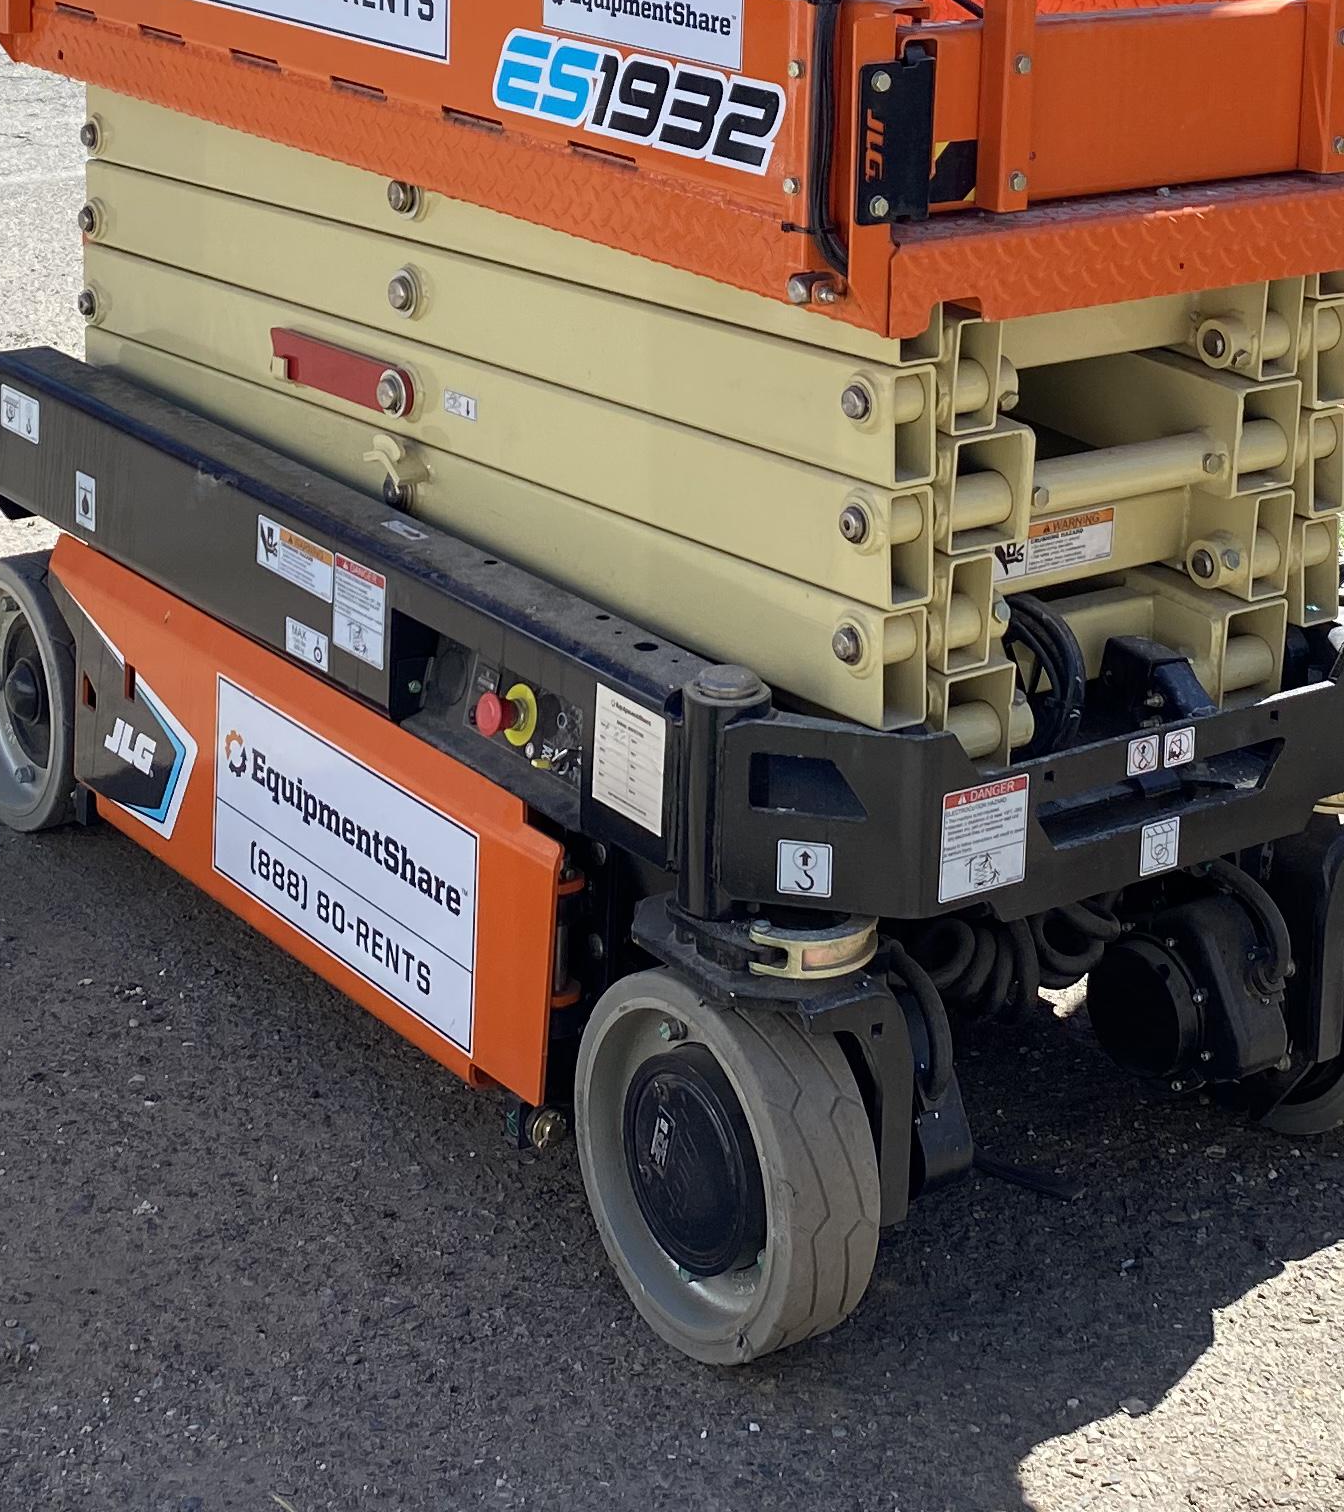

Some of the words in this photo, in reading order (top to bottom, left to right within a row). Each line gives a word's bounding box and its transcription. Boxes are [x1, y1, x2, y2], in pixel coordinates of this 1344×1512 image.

[496, 34, 781, 169] ES1932
[866, 108, 885, 183] JLG
[1053, 513, 1100, 532] WARNING
[104, 717, 156, 775] JLG
[970, 780, 1016, 802] DANGER
[252, 748, 461, 916] EquipmentShare
[250, 840, 308, 910] (888)
[316, 889, 431, 996] 80-RENTS
